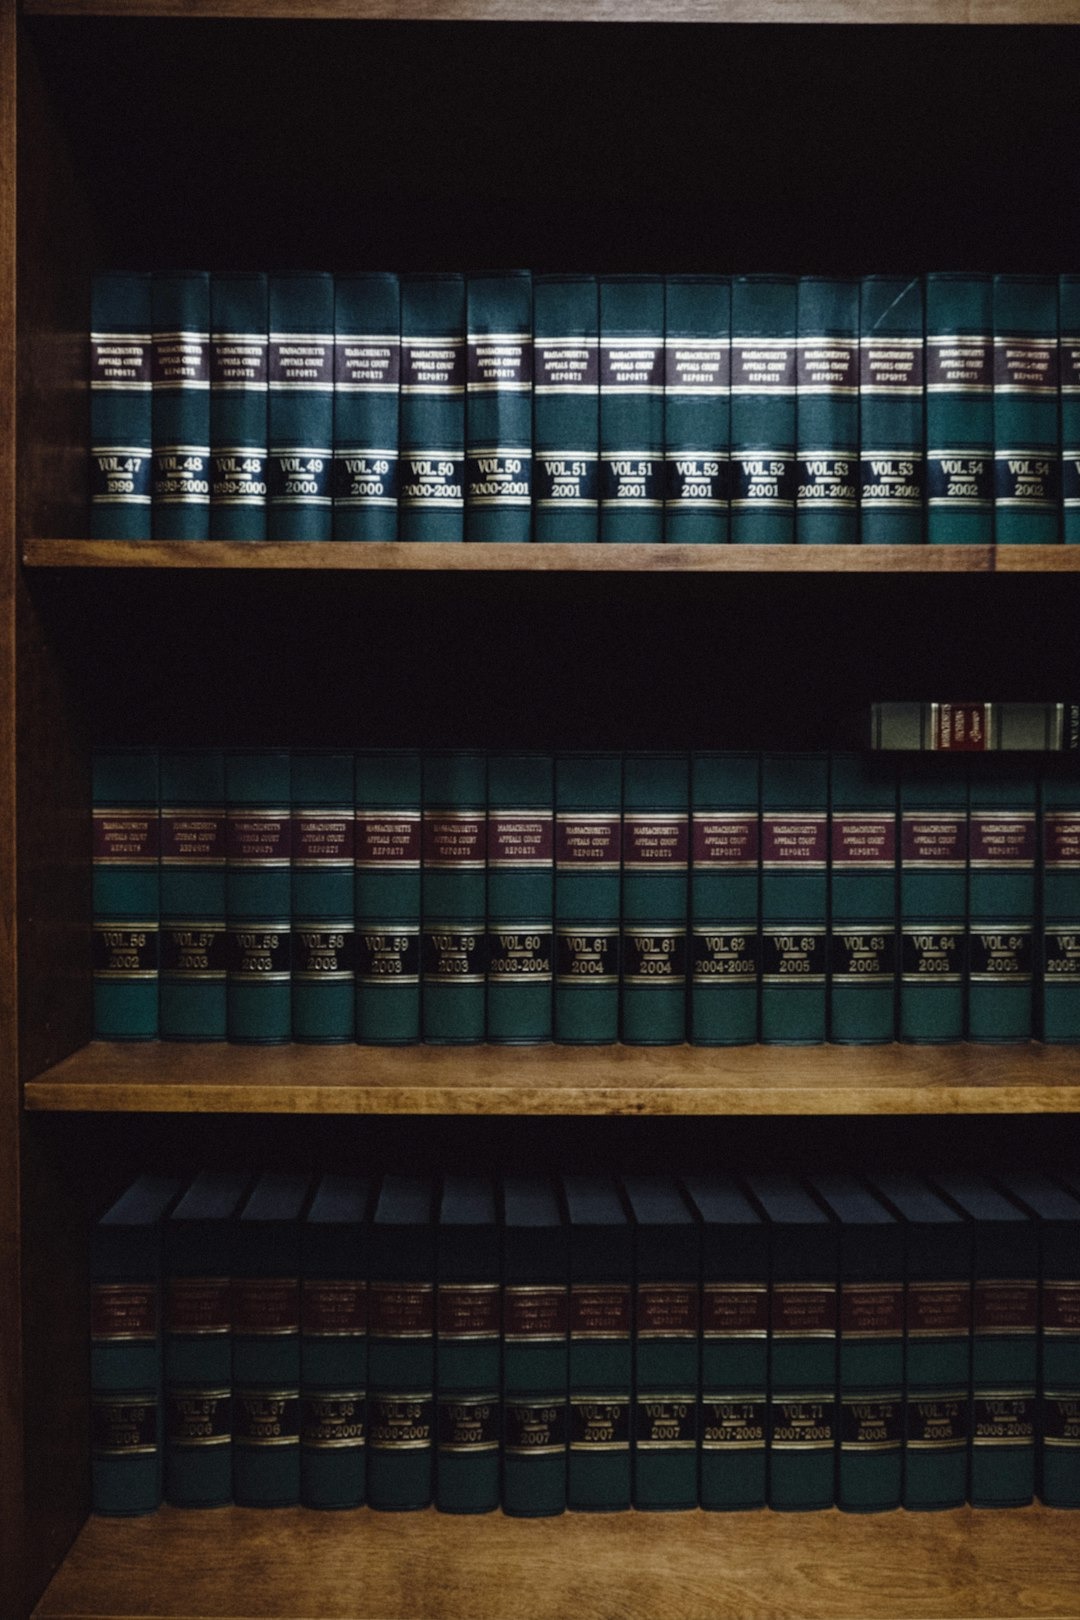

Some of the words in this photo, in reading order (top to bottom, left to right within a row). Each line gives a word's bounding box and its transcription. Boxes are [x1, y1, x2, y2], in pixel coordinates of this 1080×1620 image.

[286, 482, 317, 493] 2000
[351, 483, 383, 495] 2000
[471, 482, 529, 495] 2000-2001
[552, 485, 580, 497] 2001
[618, 485, 646, 497] 2001
[682, 485, 712, 497] 2001
[748, 485, 778, 496] 2001
[948, 484, 978, 496] 2002
[1015, 484, 1044, 496] 2002
[525, 936, 540, 950] 60
[372, 960, 402, 972] 2003
[572, 962, 604, 973] 2004
[640, 961, 671, 973] 2004
[780, 960, 810, 972] 2005
[849, 960, 879, 971] 2005
[919, 959, 949, 971] 2005
[584, 1428, 614, 1440] 2007
[652, 1427, 681, 1439] 2007
